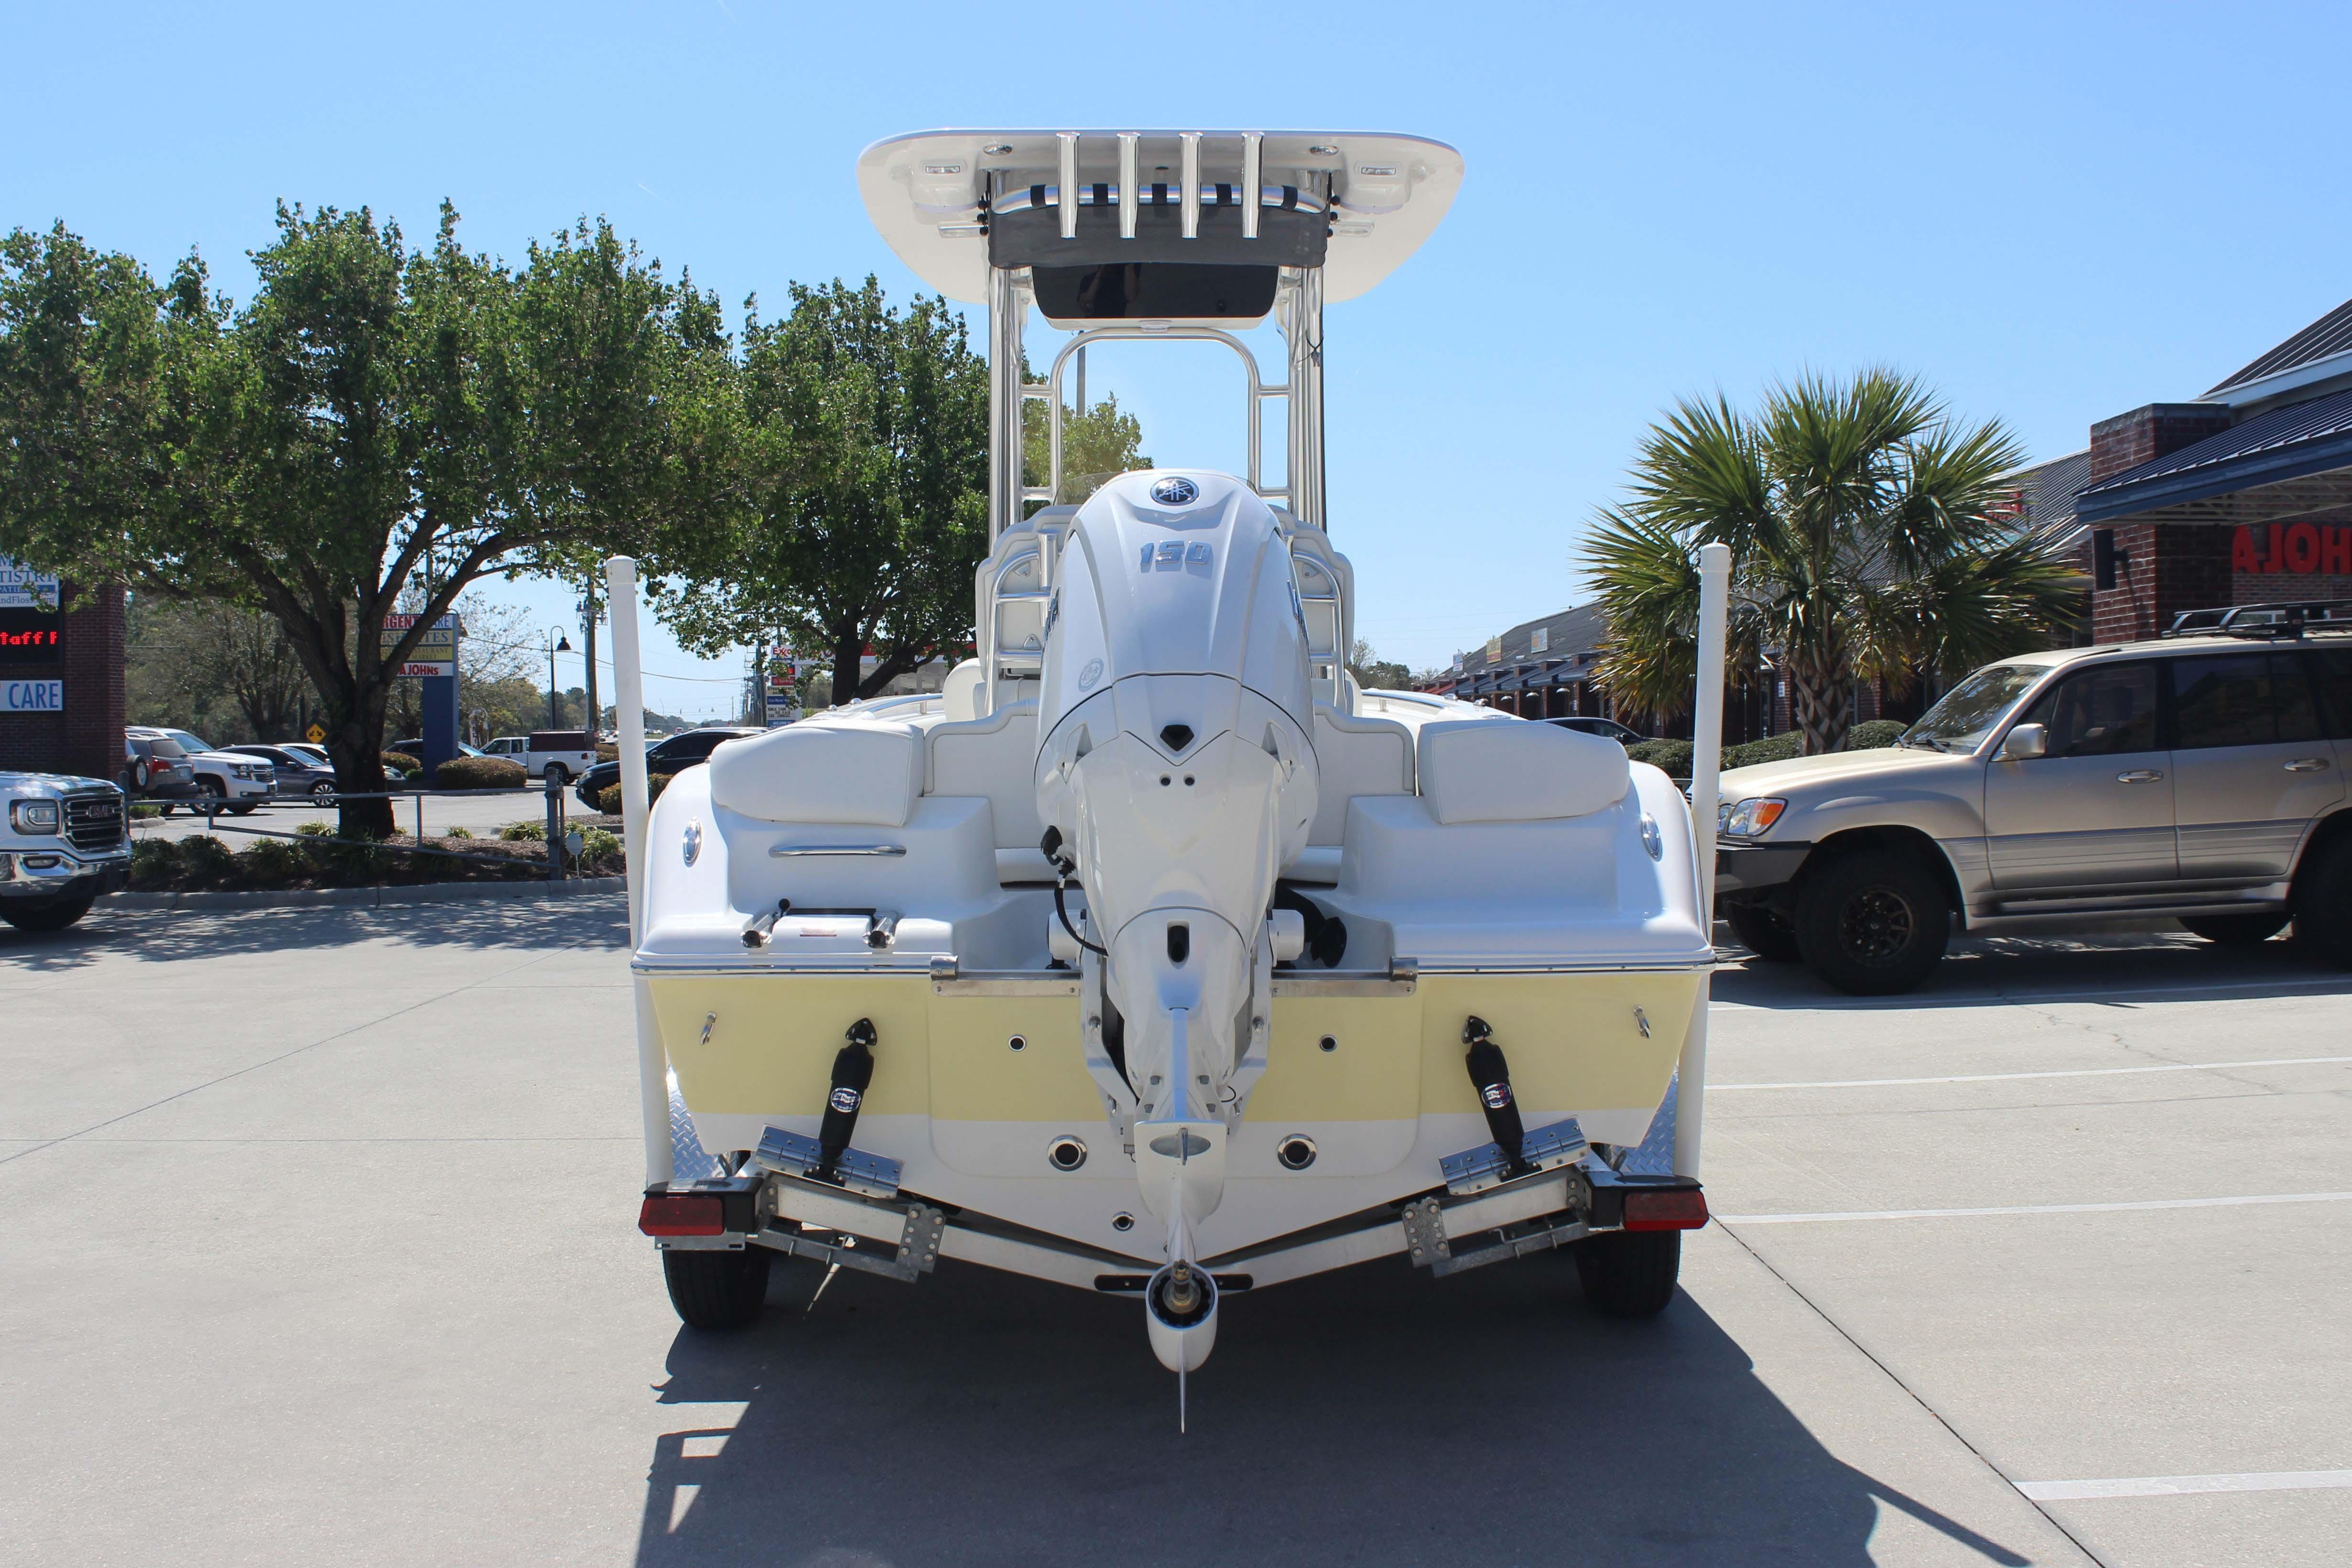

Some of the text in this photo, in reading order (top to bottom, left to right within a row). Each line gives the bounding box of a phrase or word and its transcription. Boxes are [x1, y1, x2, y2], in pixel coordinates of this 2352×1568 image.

[1140, 540, 1213, 565] 150
[383, 615, 420, 628] RGENT
[9, 683, 59, 709] CARE
[89, 805, 114, 818] GMC
